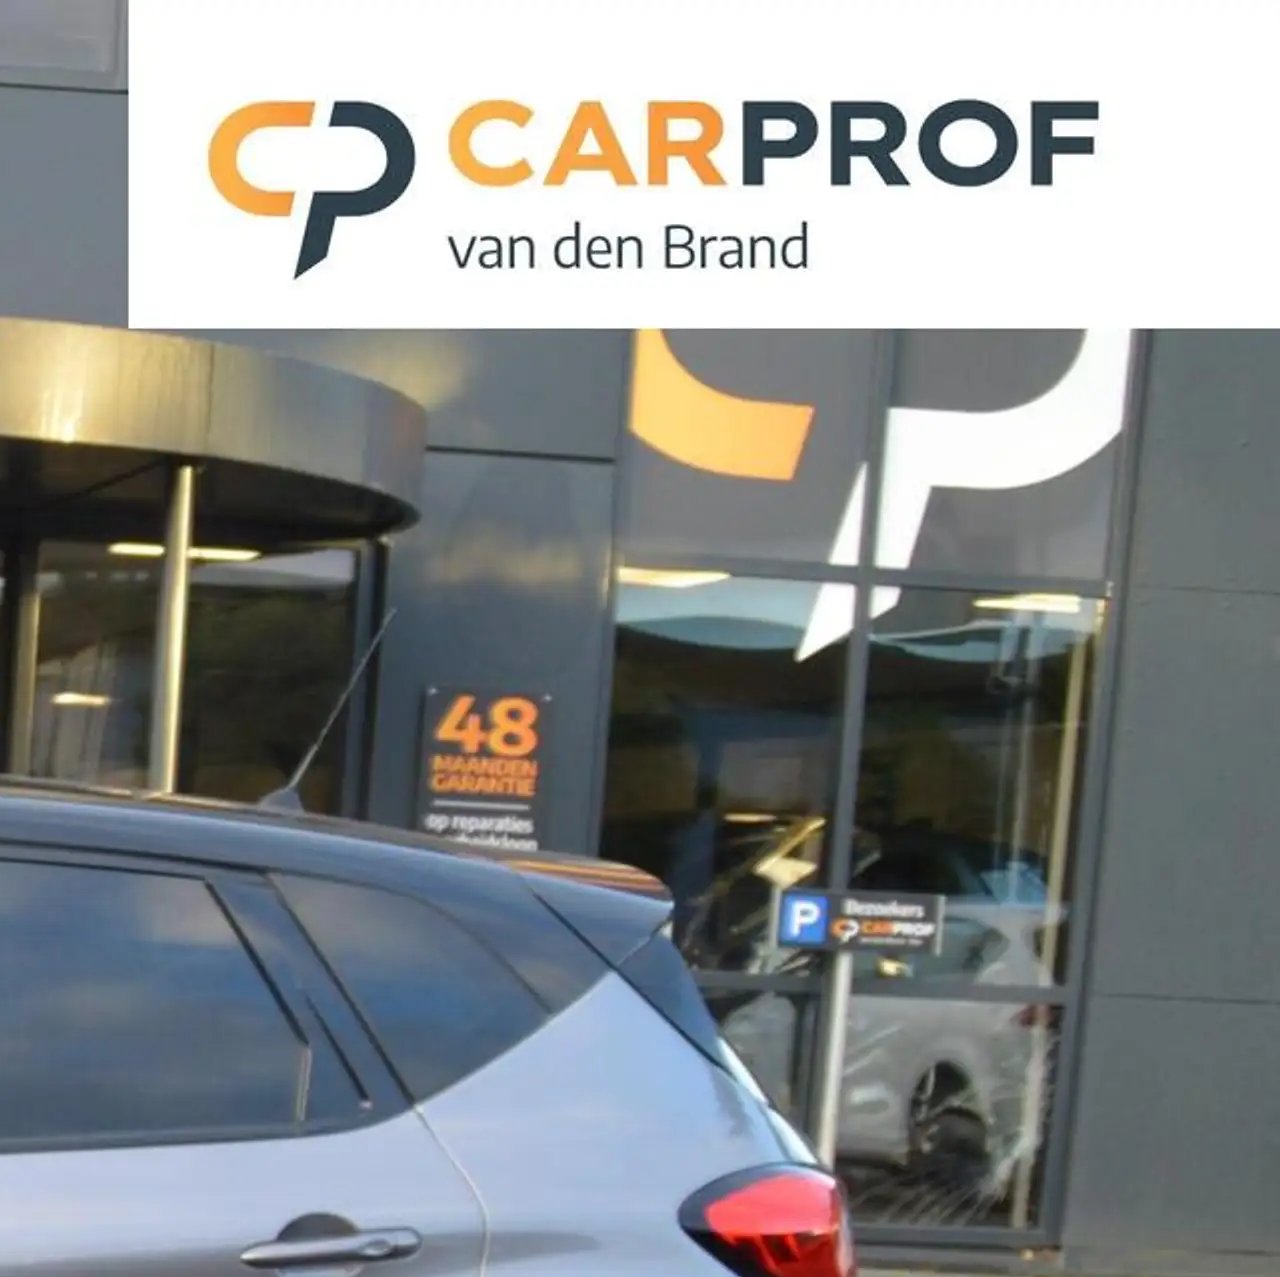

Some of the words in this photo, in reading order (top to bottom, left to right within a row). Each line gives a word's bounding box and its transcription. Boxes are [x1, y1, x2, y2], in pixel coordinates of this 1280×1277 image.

[435, 693, 539, 757] 48
[433, 755, 539, 777] MAANDEN
[432, 773, 537, 797] GARANTIE
[427, 814, 450, 833] op
[452, 815, 535, 834] reparaties
